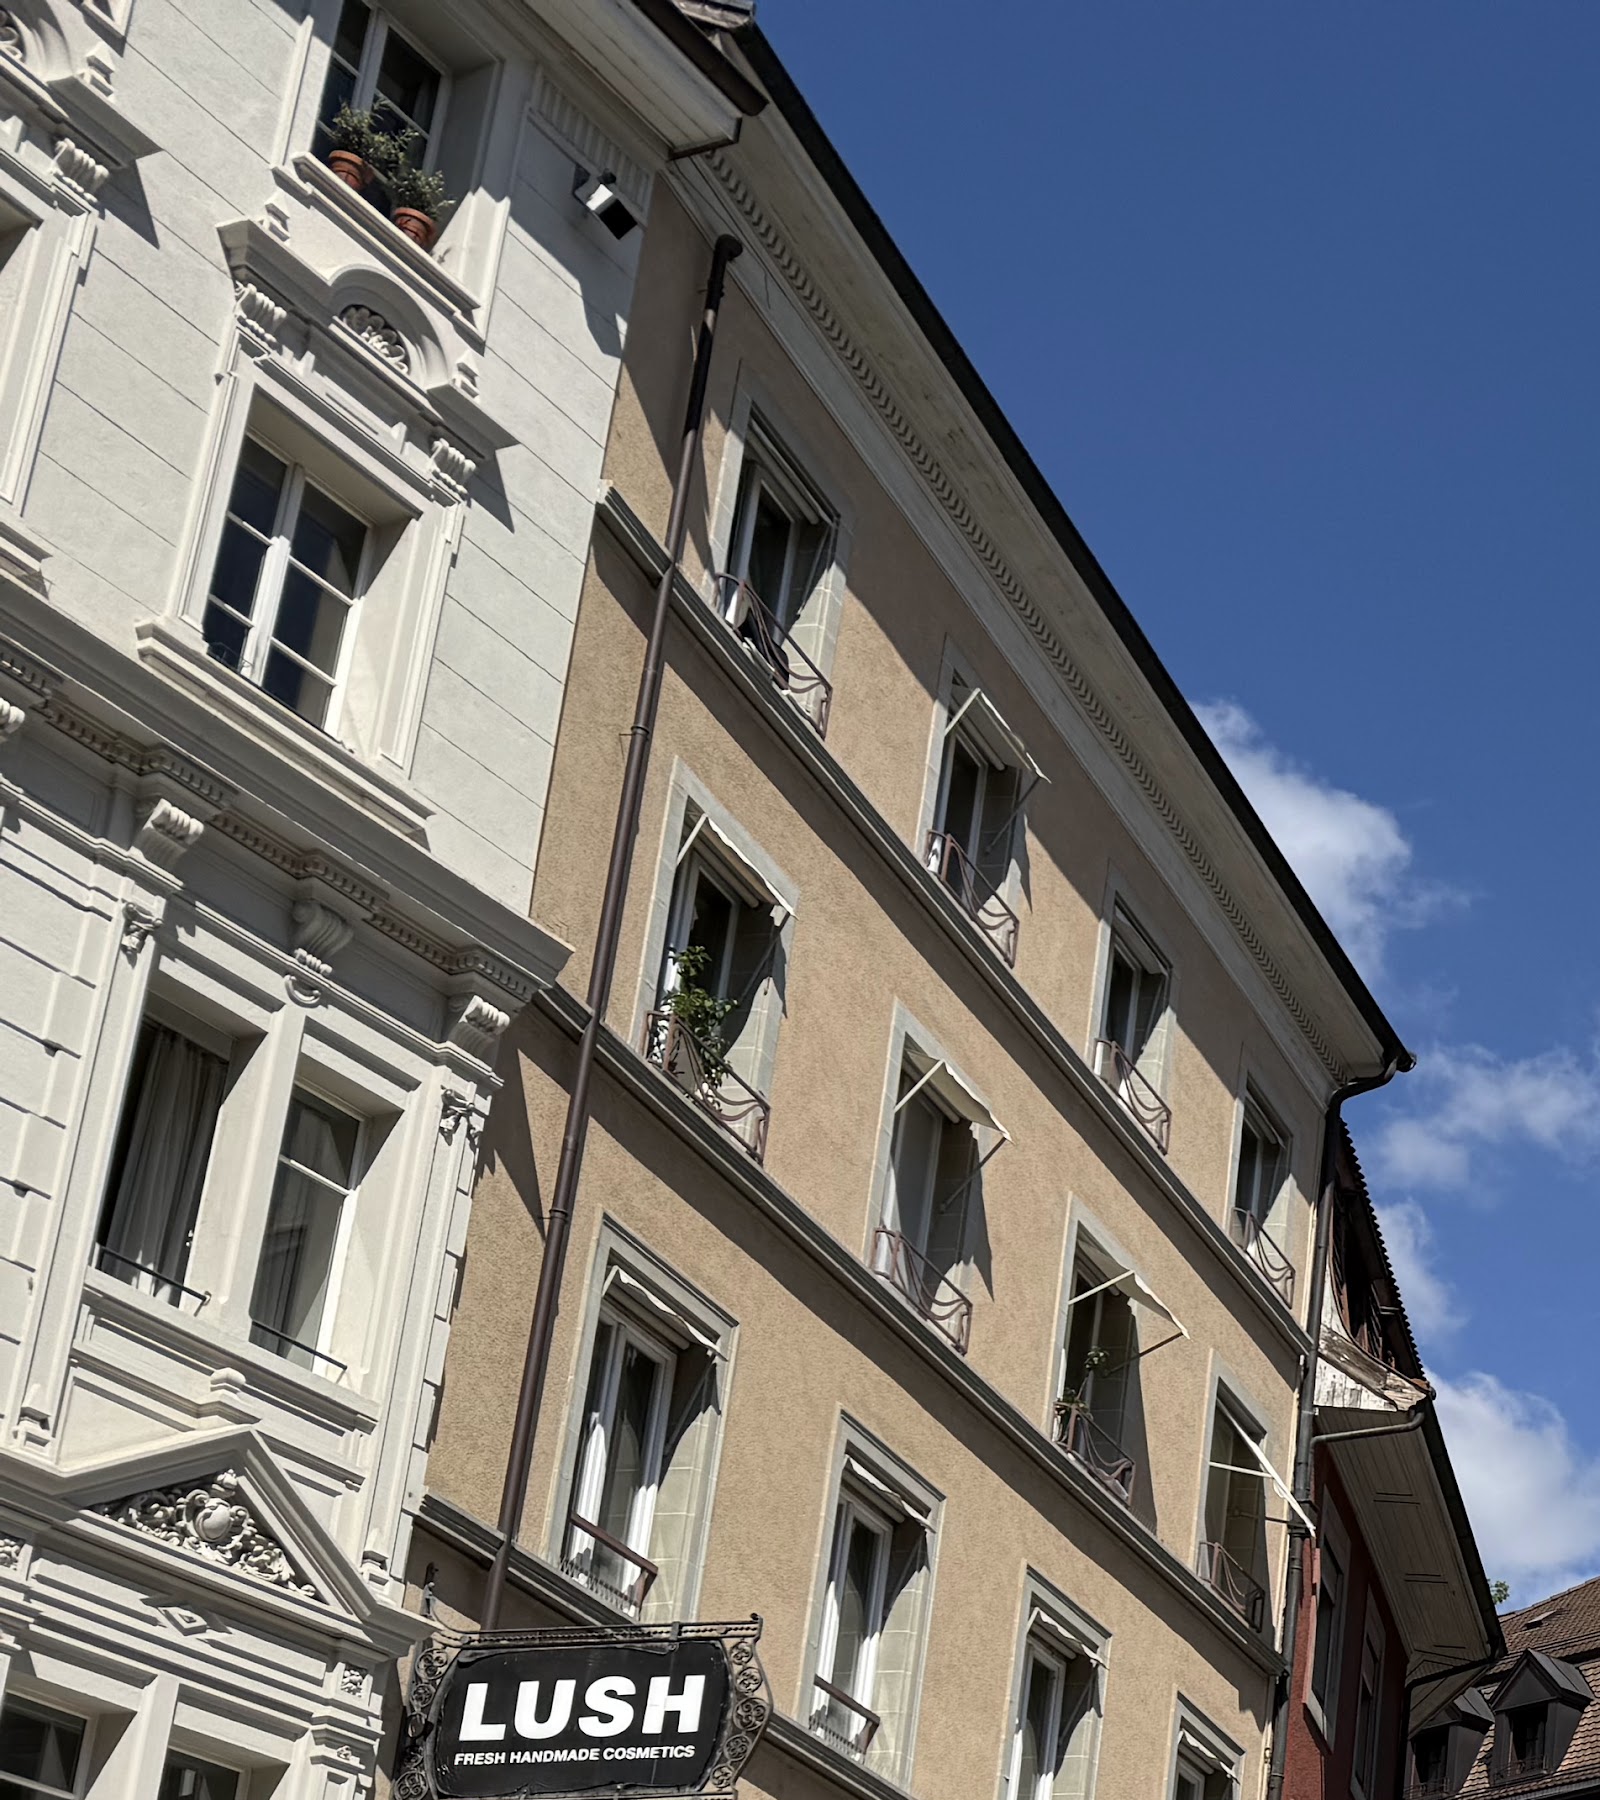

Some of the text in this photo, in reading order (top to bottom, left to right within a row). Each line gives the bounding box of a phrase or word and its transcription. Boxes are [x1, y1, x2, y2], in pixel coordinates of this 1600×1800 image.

[458, 1674, 706, 1741] LUSH
[454, 1745, 696, 1766] FRESH HANDMADE COSMETICS
